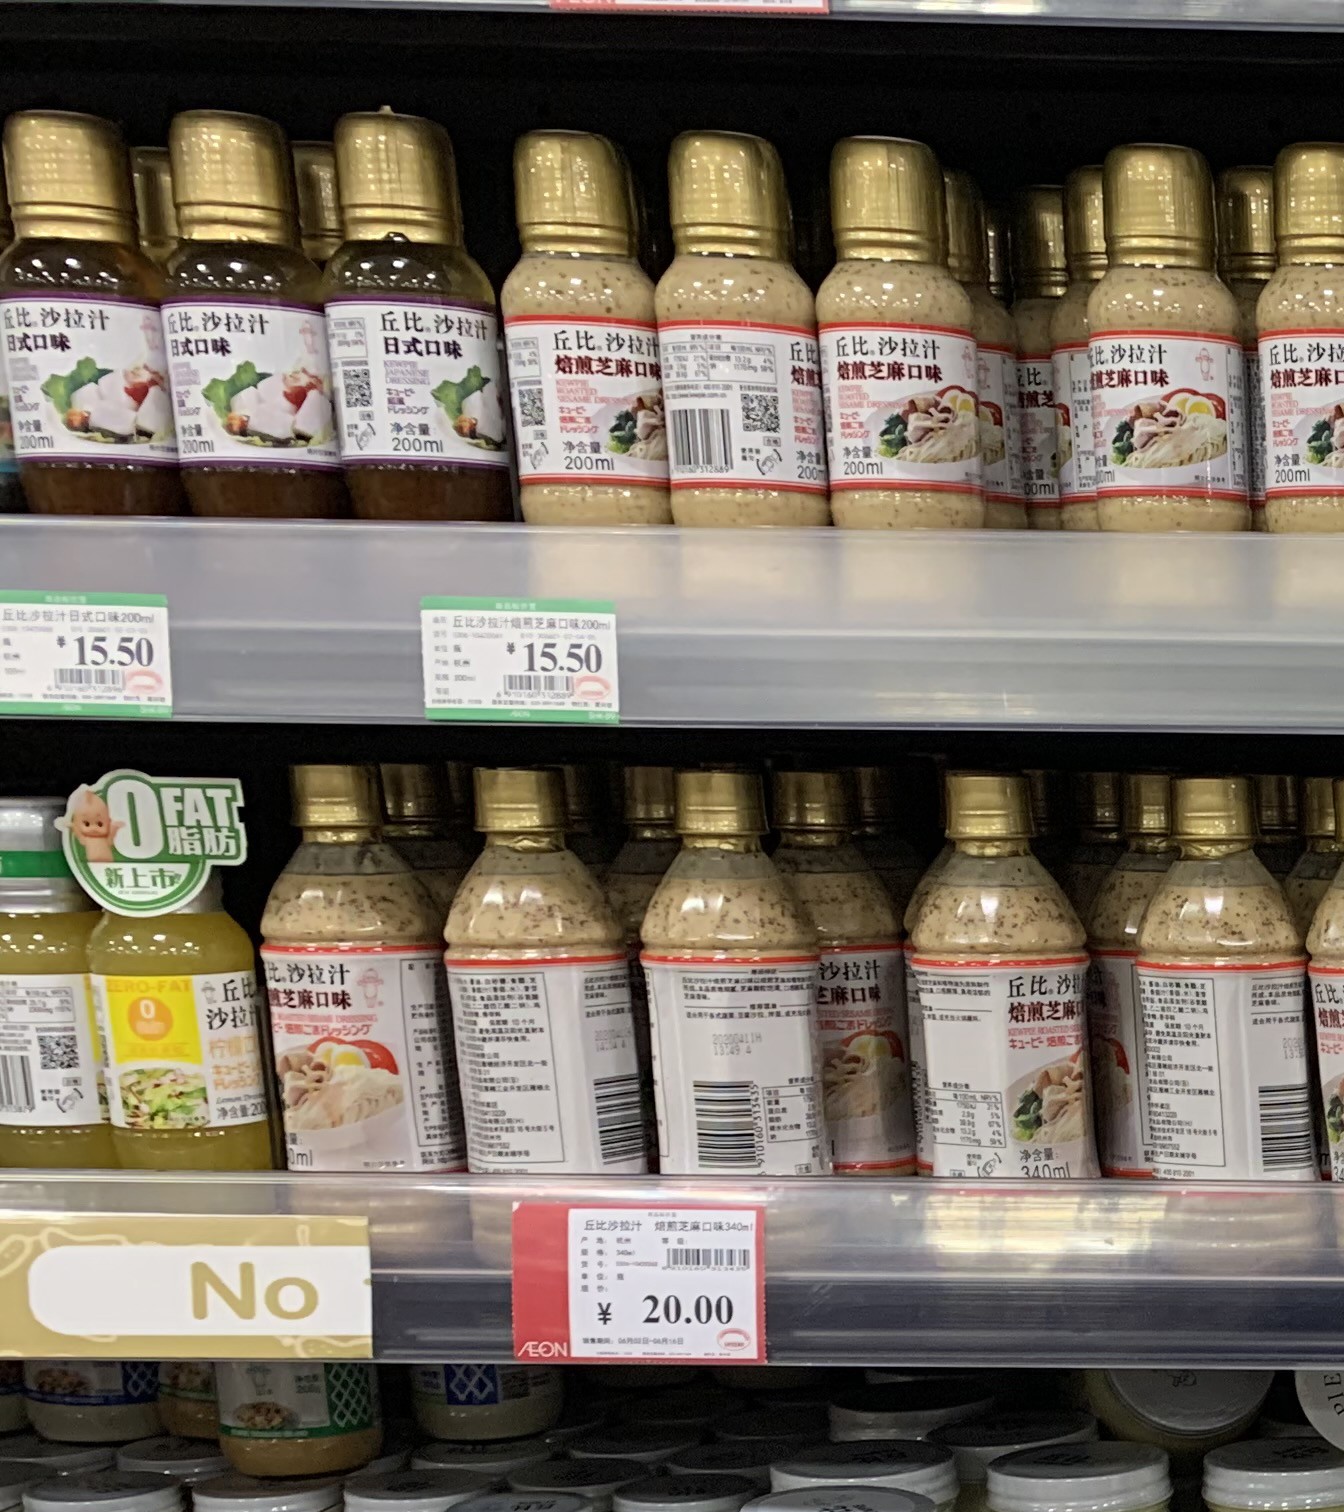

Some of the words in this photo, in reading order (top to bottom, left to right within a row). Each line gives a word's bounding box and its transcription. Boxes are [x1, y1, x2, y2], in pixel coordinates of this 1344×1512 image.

[384, 336, 464, 361] 日式口味
[837, 359, 942, 383] 焙煎芝麻口味
[392, 436, 444, 454] 200ml
[74, 635, 154, 667] 15.50
[523, 643, 602, 674] 15.50
[114, 780, 160, 858] 0
[159, 788, 232, 827] FAT
[168, 828, 237, 857] 脂肪
[584, 1220, 642, 1233] 丘比沙拉汁
[190, 1261, 319, 1320] No
[643, 1294, 734, 1325] 20.00
